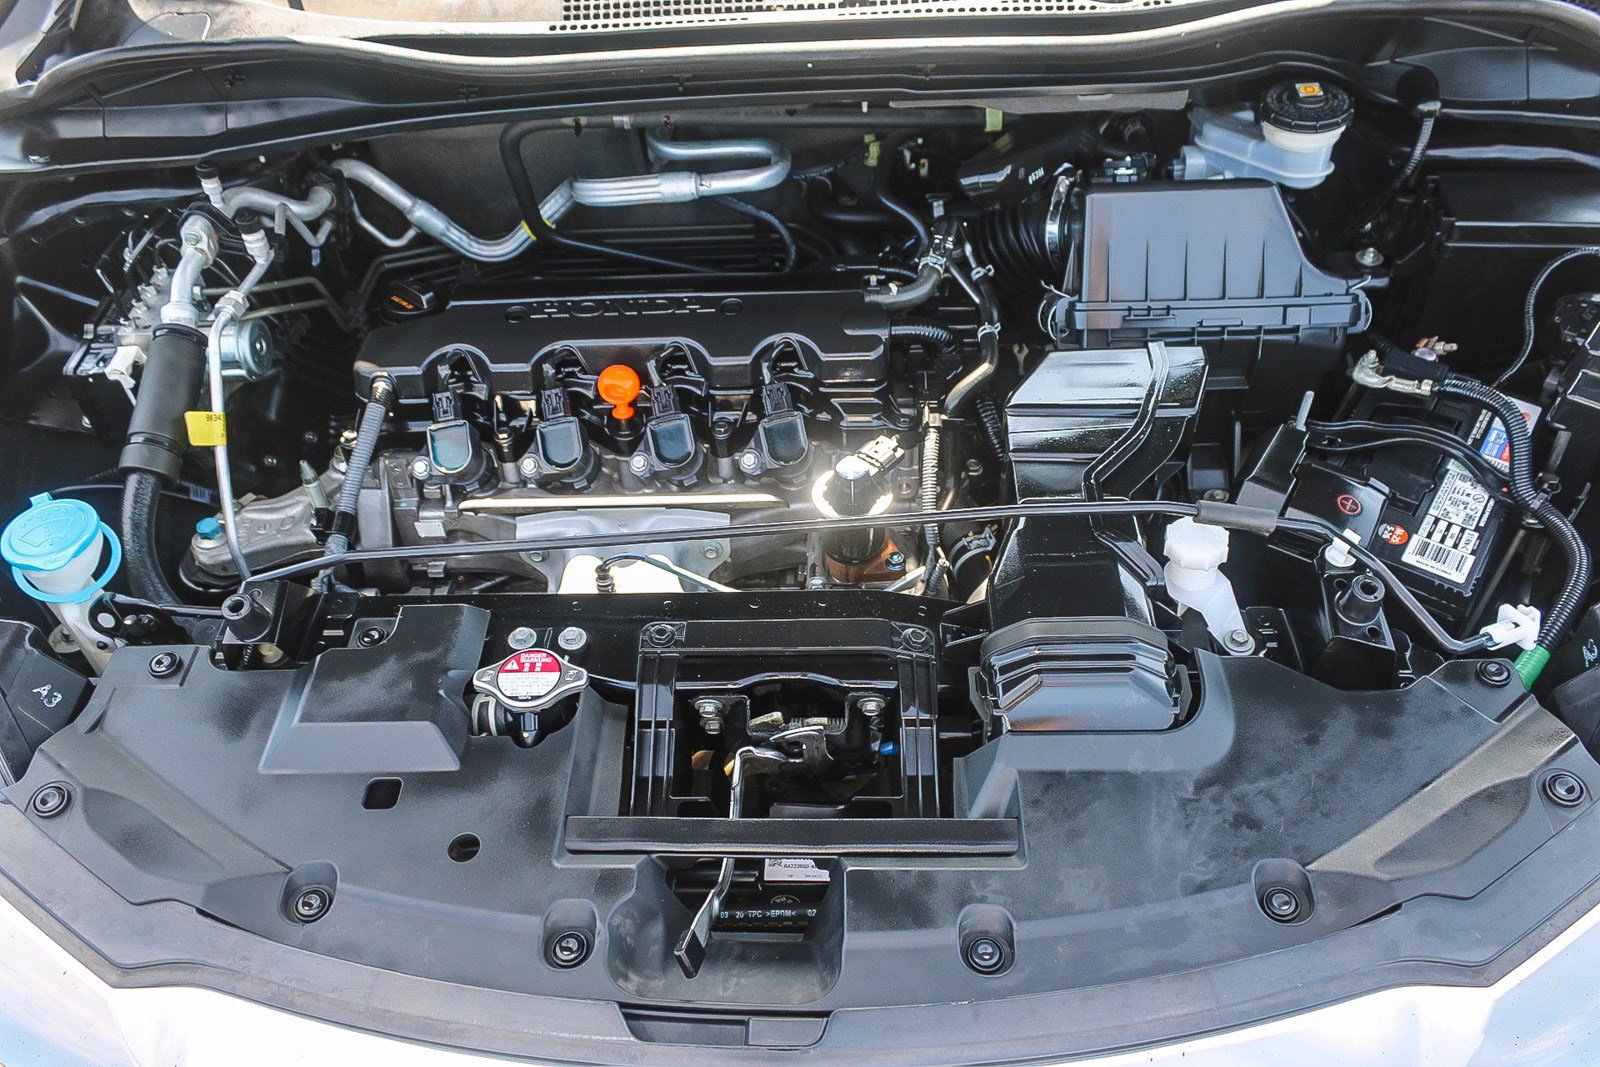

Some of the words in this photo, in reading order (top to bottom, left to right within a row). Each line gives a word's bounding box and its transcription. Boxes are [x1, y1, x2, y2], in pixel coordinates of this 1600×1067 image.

[529, 297, 716, 318] HONDA
[32, 683, 63, 708] A3
[747, 910, 763, 918] TPC
